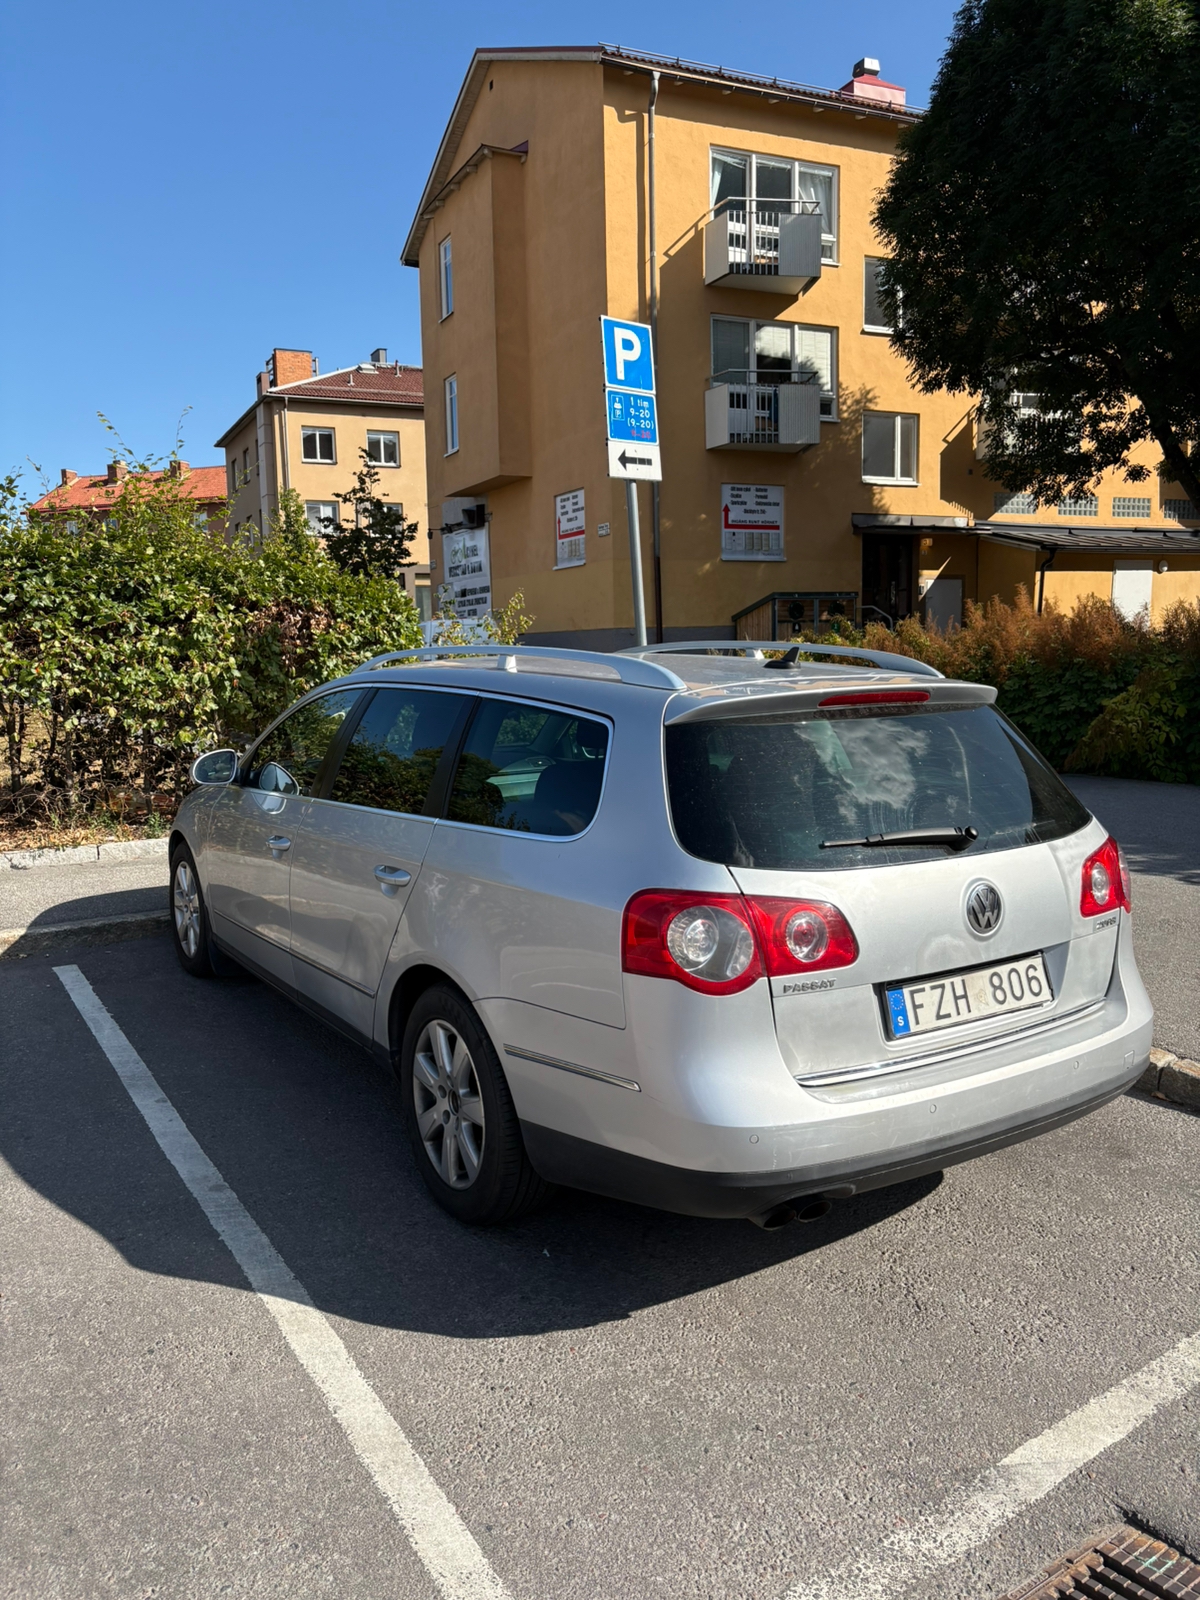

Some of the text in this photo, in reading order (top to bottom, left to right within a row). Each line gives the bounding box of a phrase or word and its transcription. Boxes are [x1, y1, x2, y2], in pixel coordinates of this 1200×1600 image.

[614, 327, 642, 381] P
[630, 396, 649, 408] 1 tim
[630, 408, 650, 418] 9-20
[627, 417, 654, 430] (9-20)
[783, 978, 837, 993] PASSAT
[897, 964, 1043, 1026] S FZH 806
